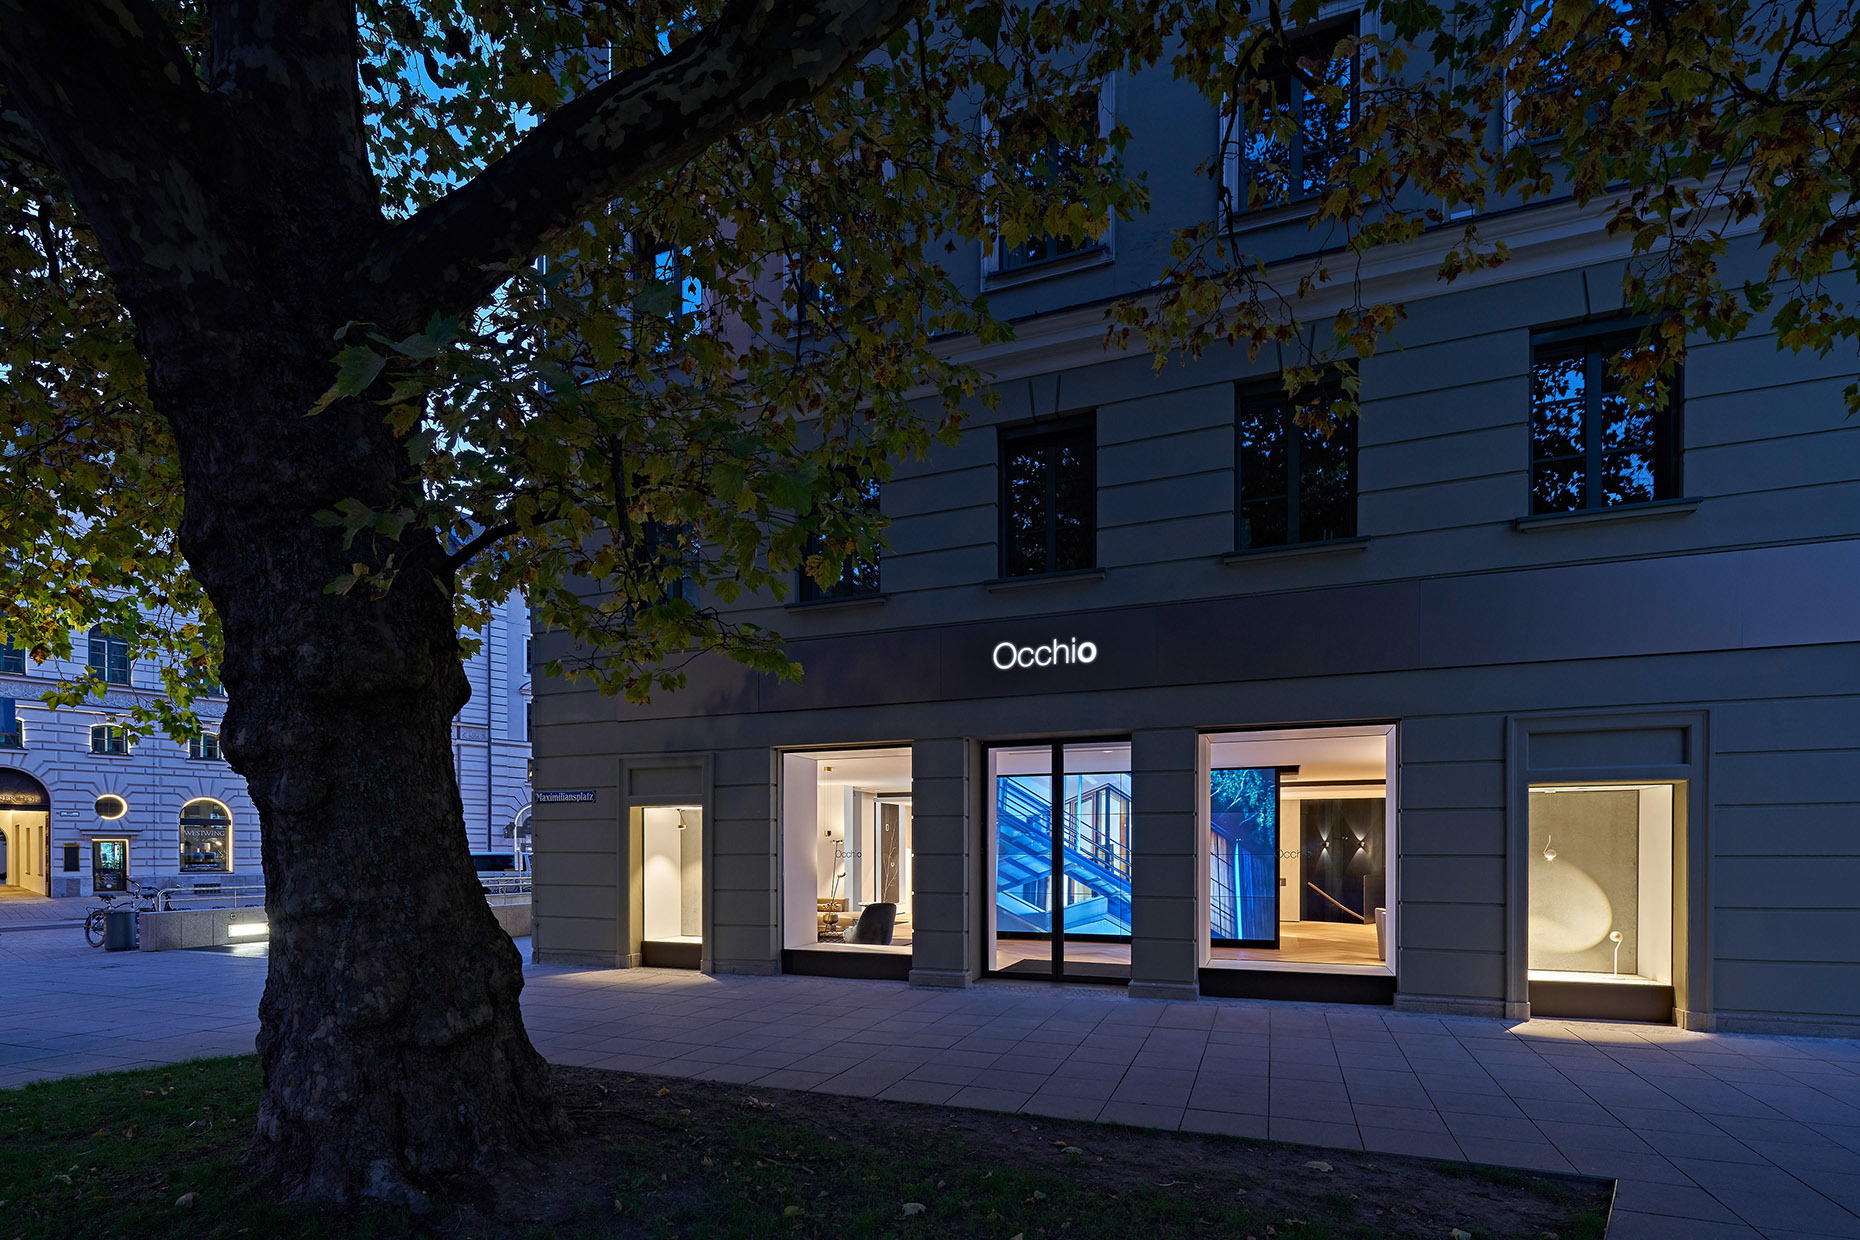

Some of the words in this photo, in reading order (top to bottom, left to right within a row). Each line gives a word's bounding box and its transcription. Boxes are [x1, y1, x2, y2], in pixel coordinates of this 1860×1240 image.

[992, 637, 1098, 670] Occhio
[536, 791, 594, 802] Maximiliansplatz
[835, 849, 862, 858] Occhio
[1275, 849, 1313, 859] Occho
